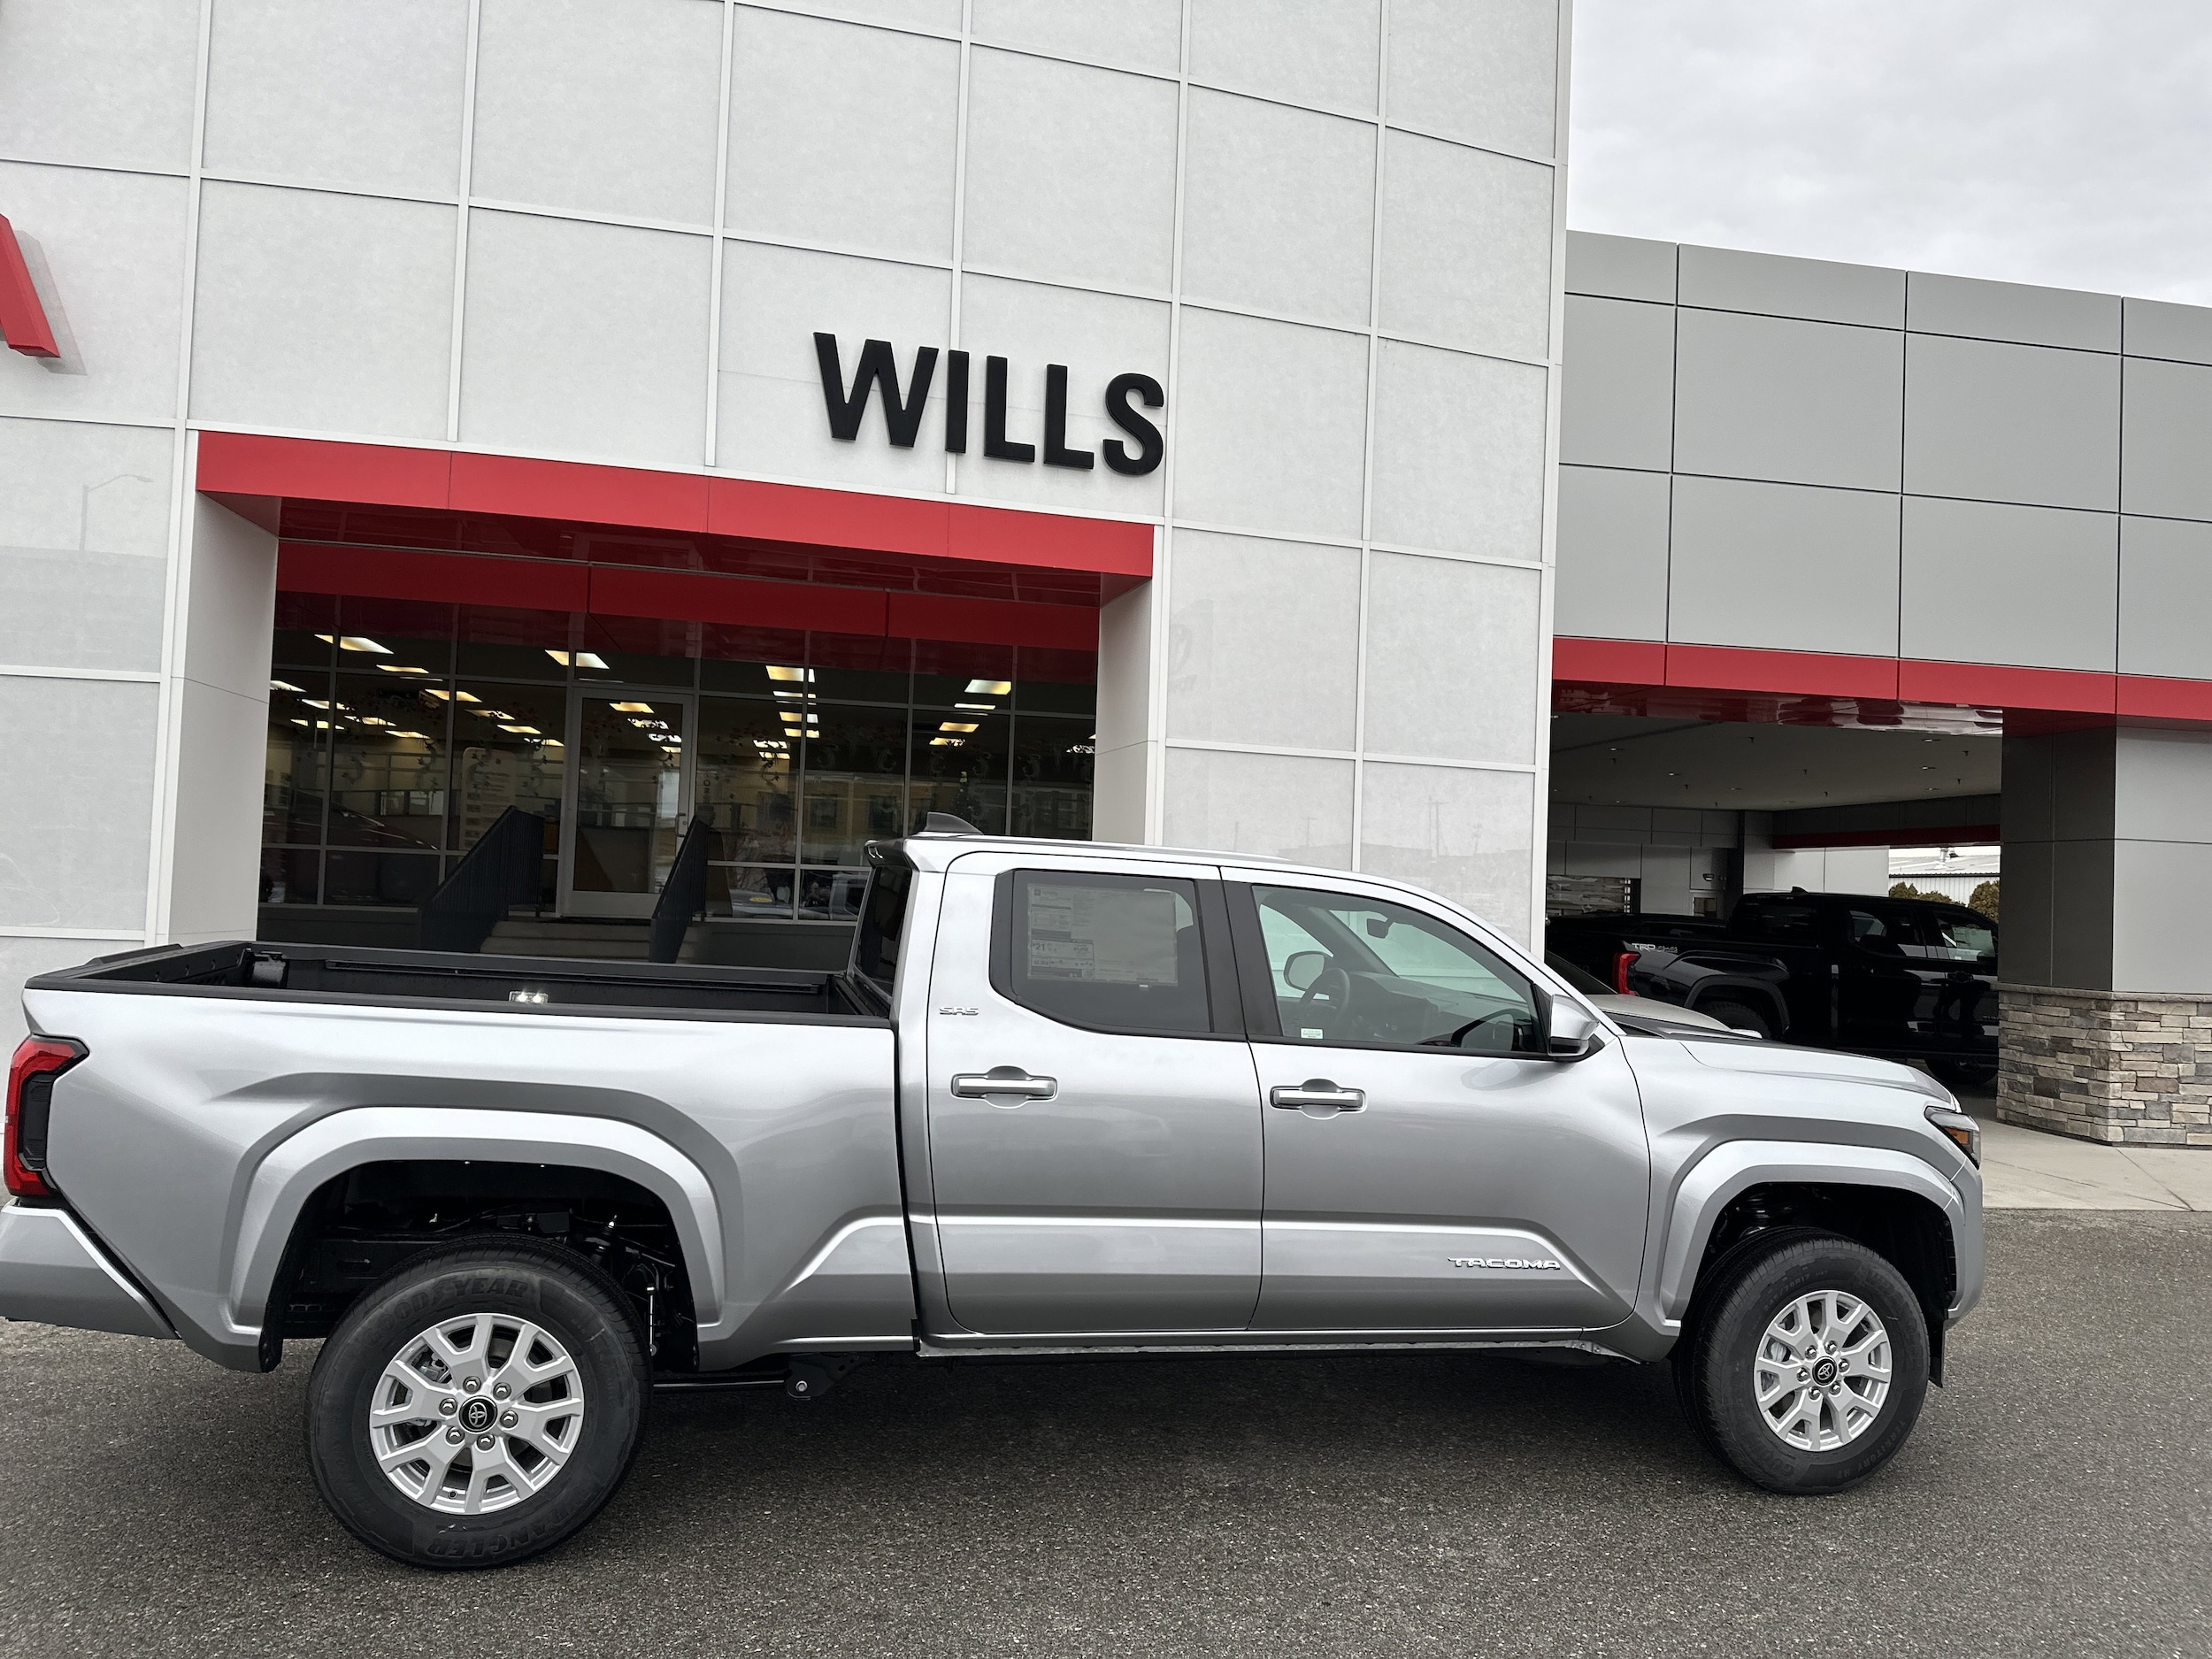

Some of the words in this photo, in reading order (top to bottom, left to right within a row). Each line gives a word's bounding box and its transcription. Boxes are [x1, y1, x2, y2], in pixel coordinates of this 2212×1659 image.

[813, 332, 1164, 475] WILLS
[1632, 943, 1655, 952] TRD
[939, 1006, 979, 1016] SR5
[1448, 1257, 1561, 1271] TACOMA
